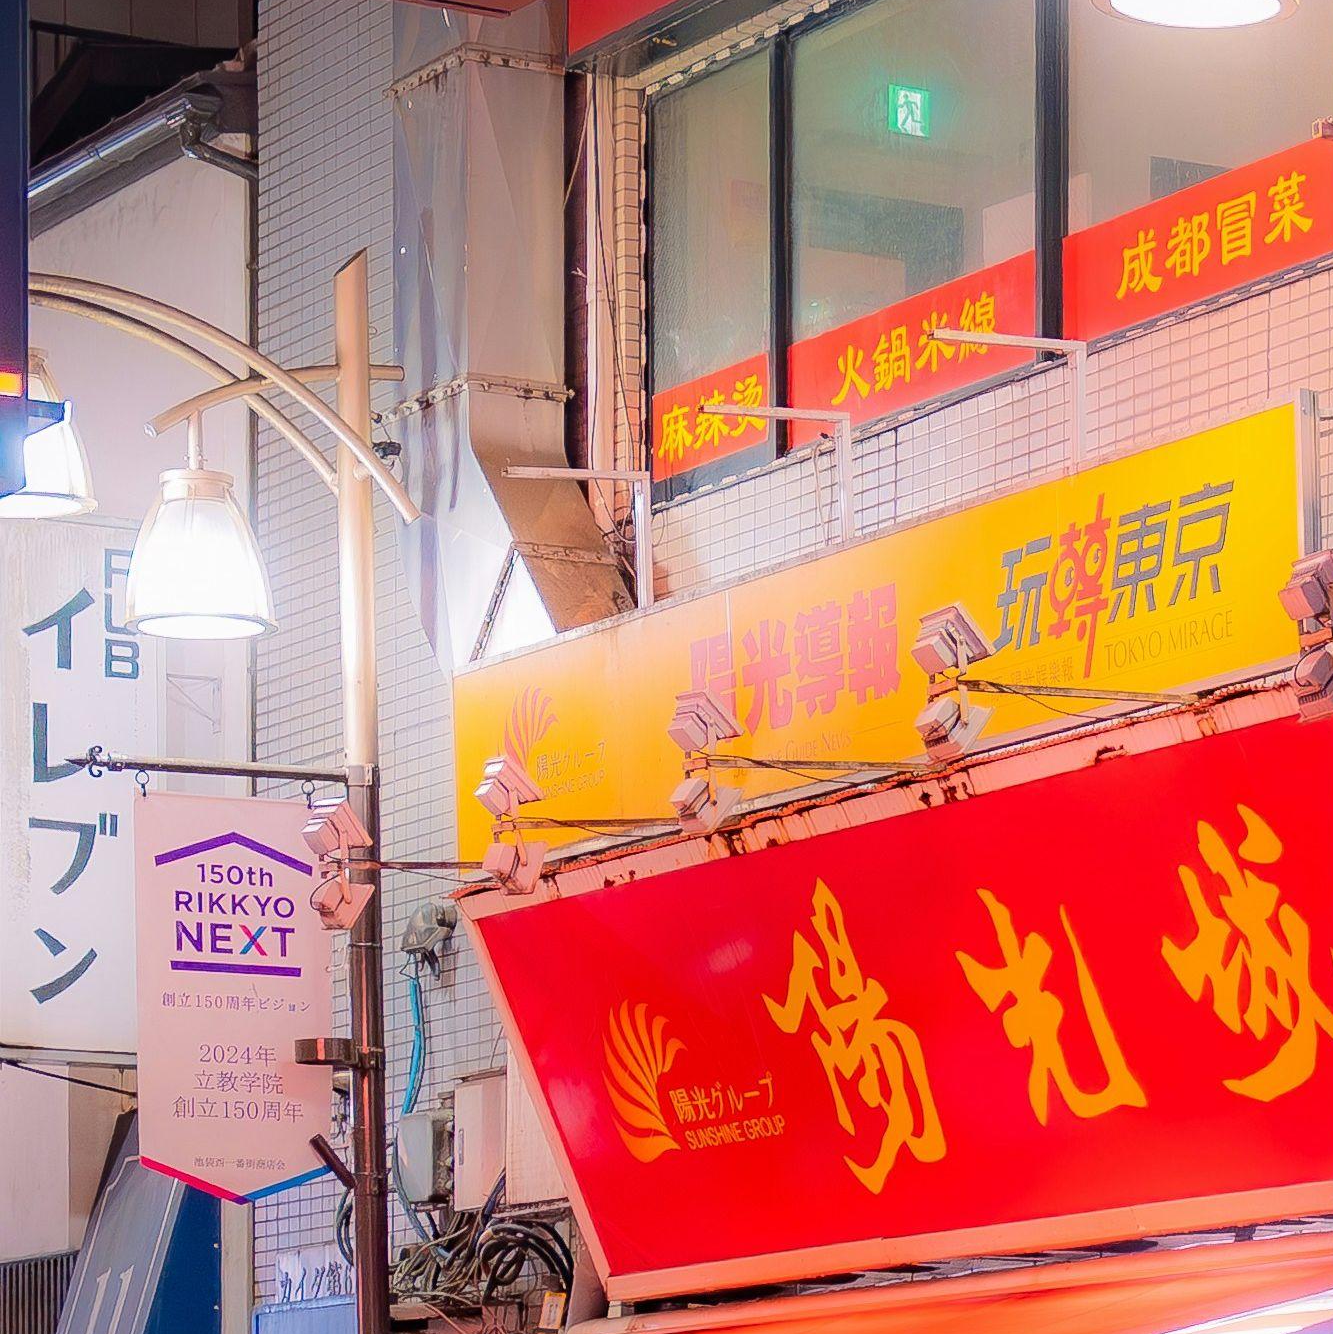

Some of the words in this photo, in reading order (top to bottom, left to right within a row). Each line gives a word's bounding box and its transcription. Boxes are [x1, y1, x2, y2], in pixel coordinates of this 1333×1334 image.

[1115, 170, 1316, 300] 成都冒菜
[829, 291, 999, 407] 火鍋米線
[657, 376, 766, 462] 麻辣烫
[1104, 636, 1163, 671] TOKYO
[1166, 609, 1234, 652] MIRAGE
[196, 863, 274, 888] 150th
[174, 890, 295, 919] RIKKYO
[175, 920, 297, 958] NEXT
[161, 990, 312, 1013] 創立150周年ビジョン
[199, 1042, 278, 1066] 2024年
[193, 1072, 284, 1095] 立教学院
[670, 1070, 774, 1126] 陽光グループ
[171, 1096, 304, 1123] 創立150周年
[684, 1121, 742, 1151] SUNSHINE
[743, 1114, 786, 1142] GROUP
